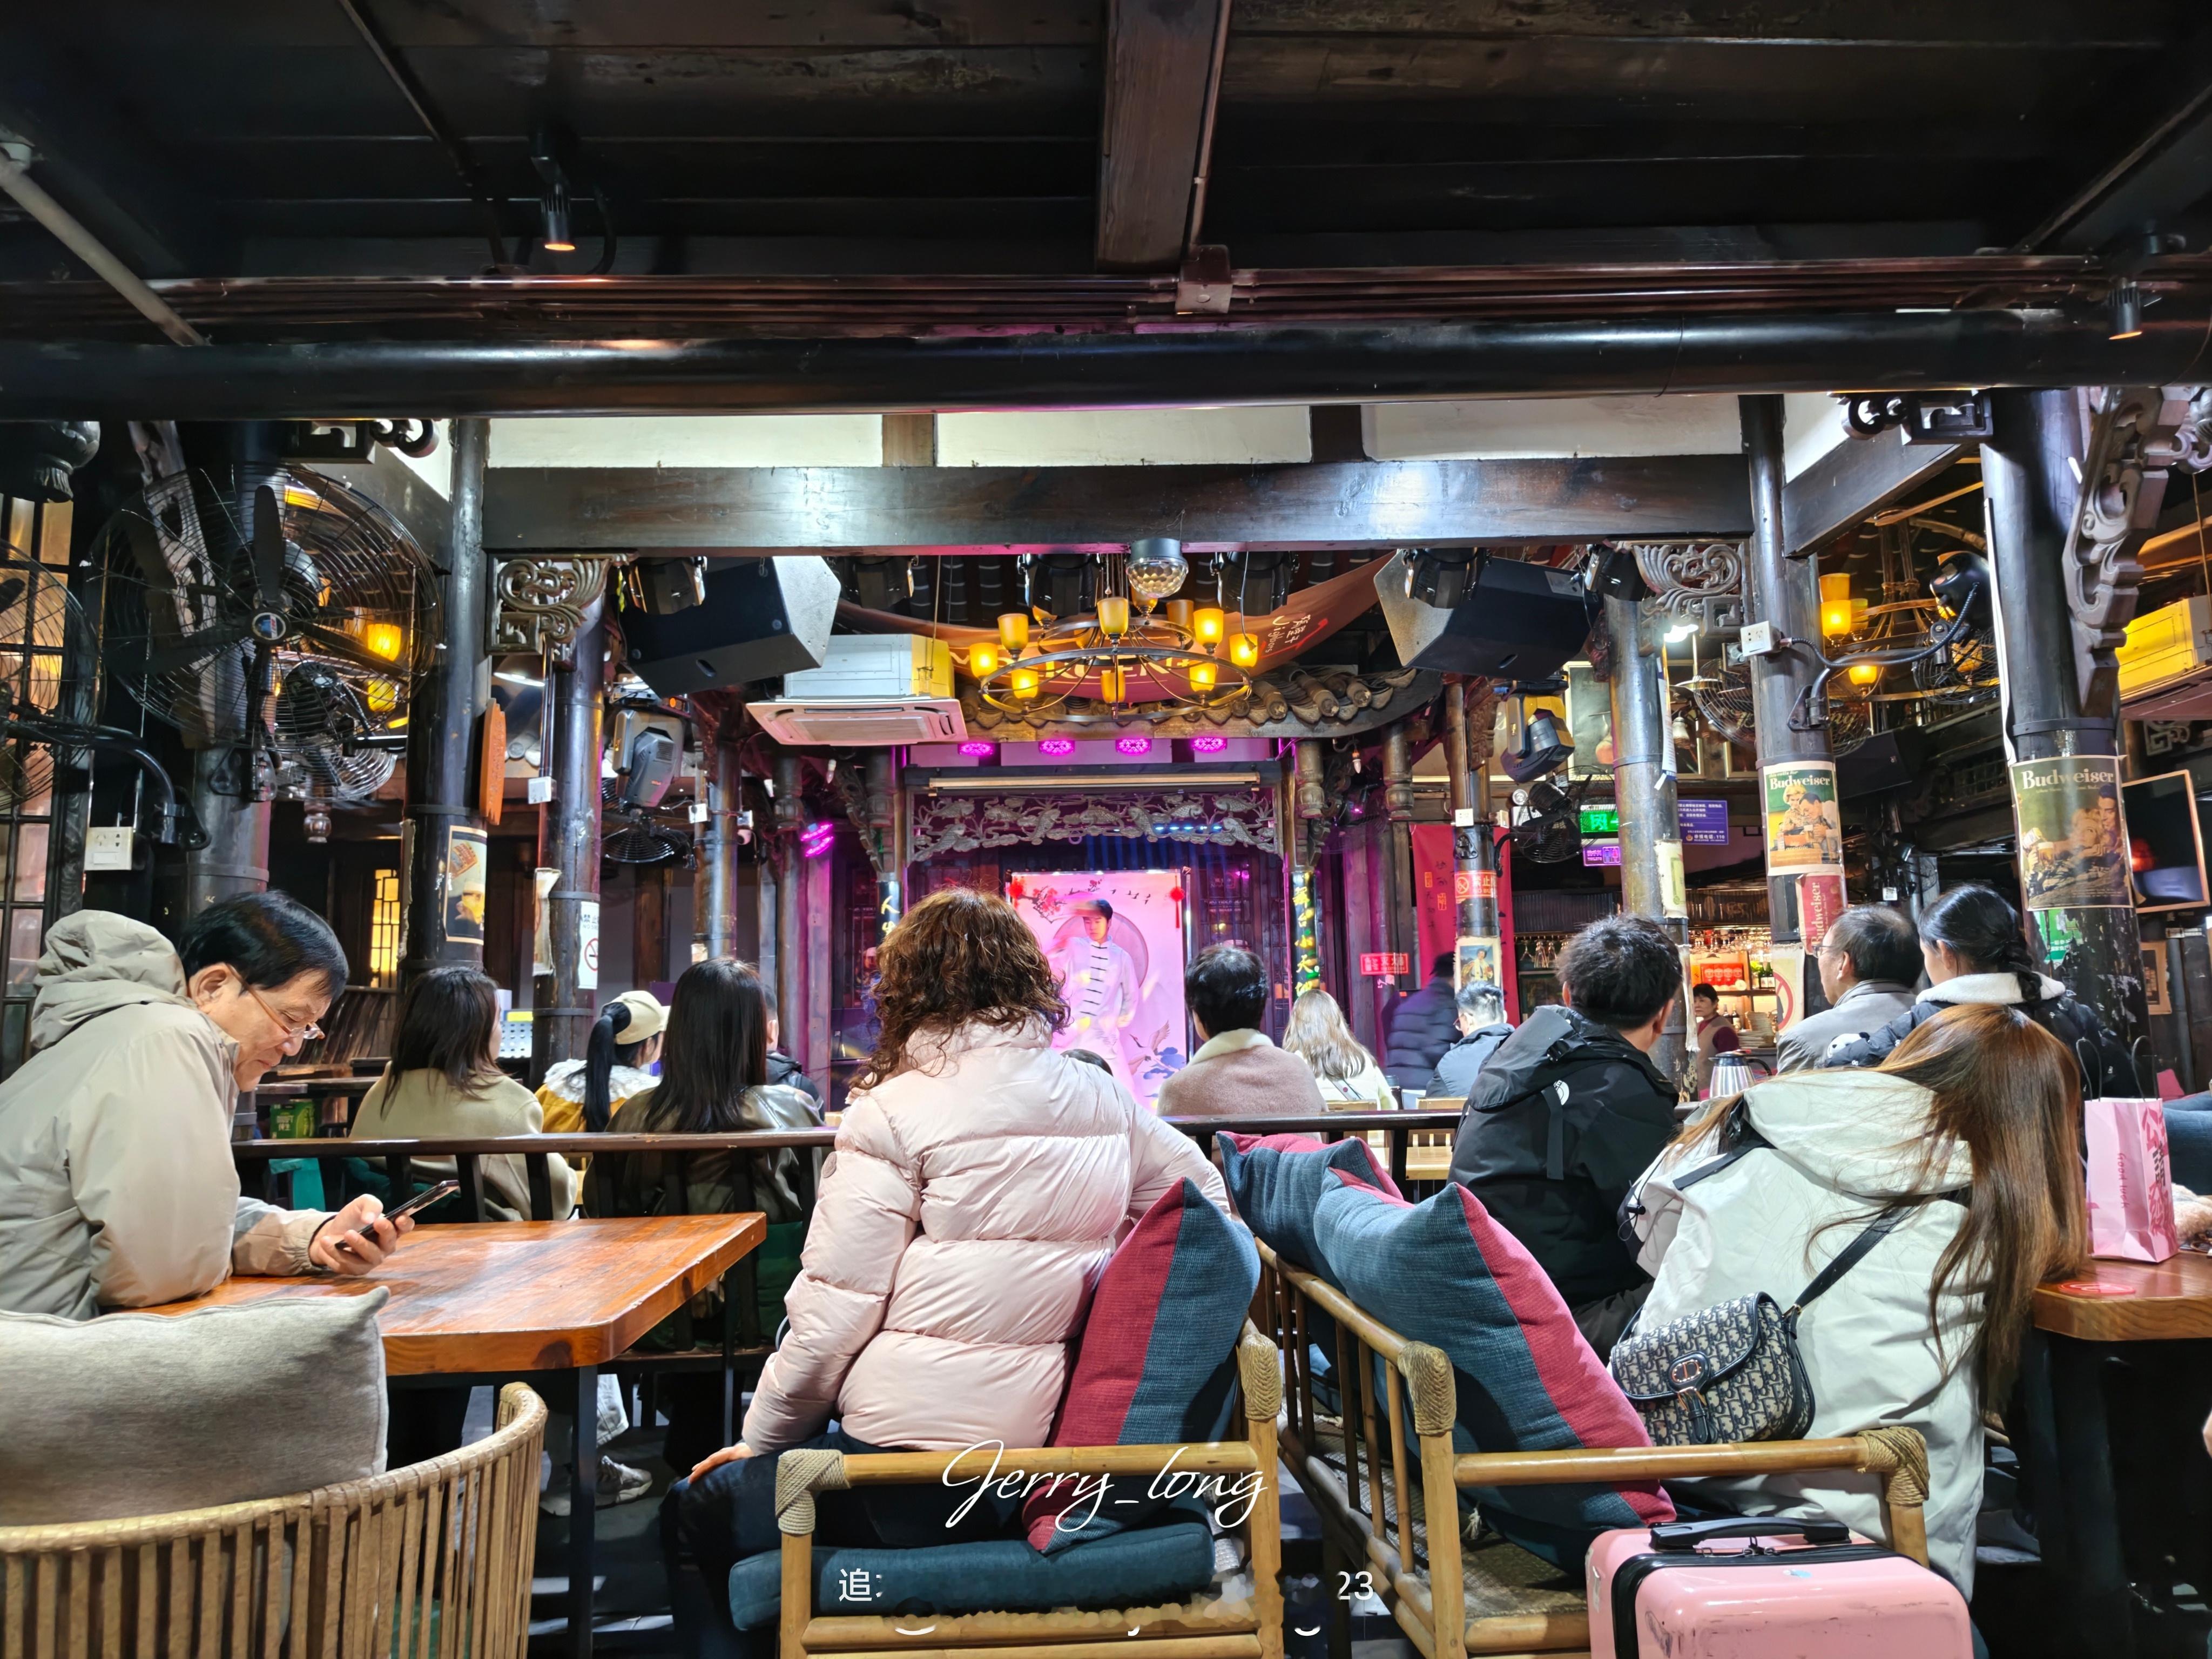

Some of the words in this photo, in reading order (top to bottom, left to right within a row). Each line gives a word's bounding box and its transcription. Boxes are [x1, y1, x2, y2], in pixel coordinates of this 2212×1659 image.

[1770, 774, 1831, 790] Budweiser
[2021, 768, 2114, 790] Budweiser
[1811, 882, 1825, 946] Budweiser
